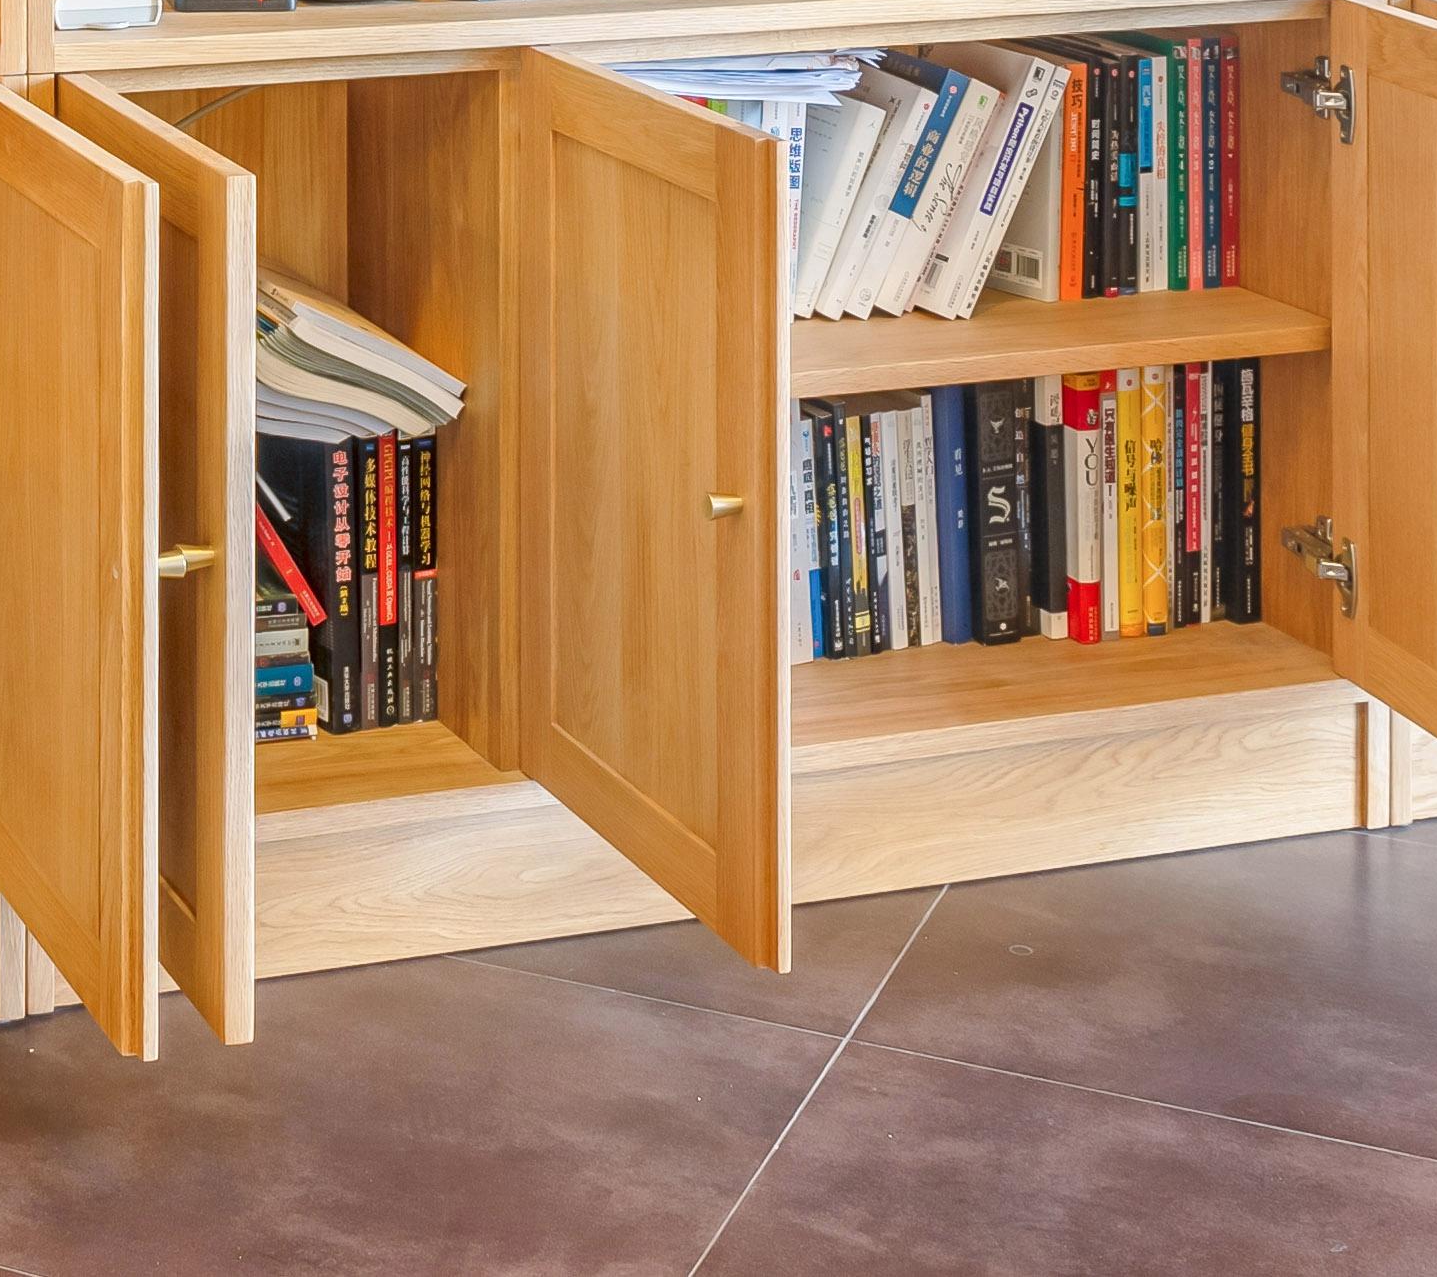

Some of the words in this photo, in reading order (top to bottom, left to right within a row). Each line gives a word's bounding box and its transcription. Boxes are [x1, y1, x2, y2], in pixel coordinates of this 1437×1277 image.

[333, 451, 352, 583] 电子设计从零开始
[364, 457, 378, 568] 多媒体技术教程
[419, 451, 431, 566] 神经网络与机器学习
[1085, 436, 1101, 487] YOU
